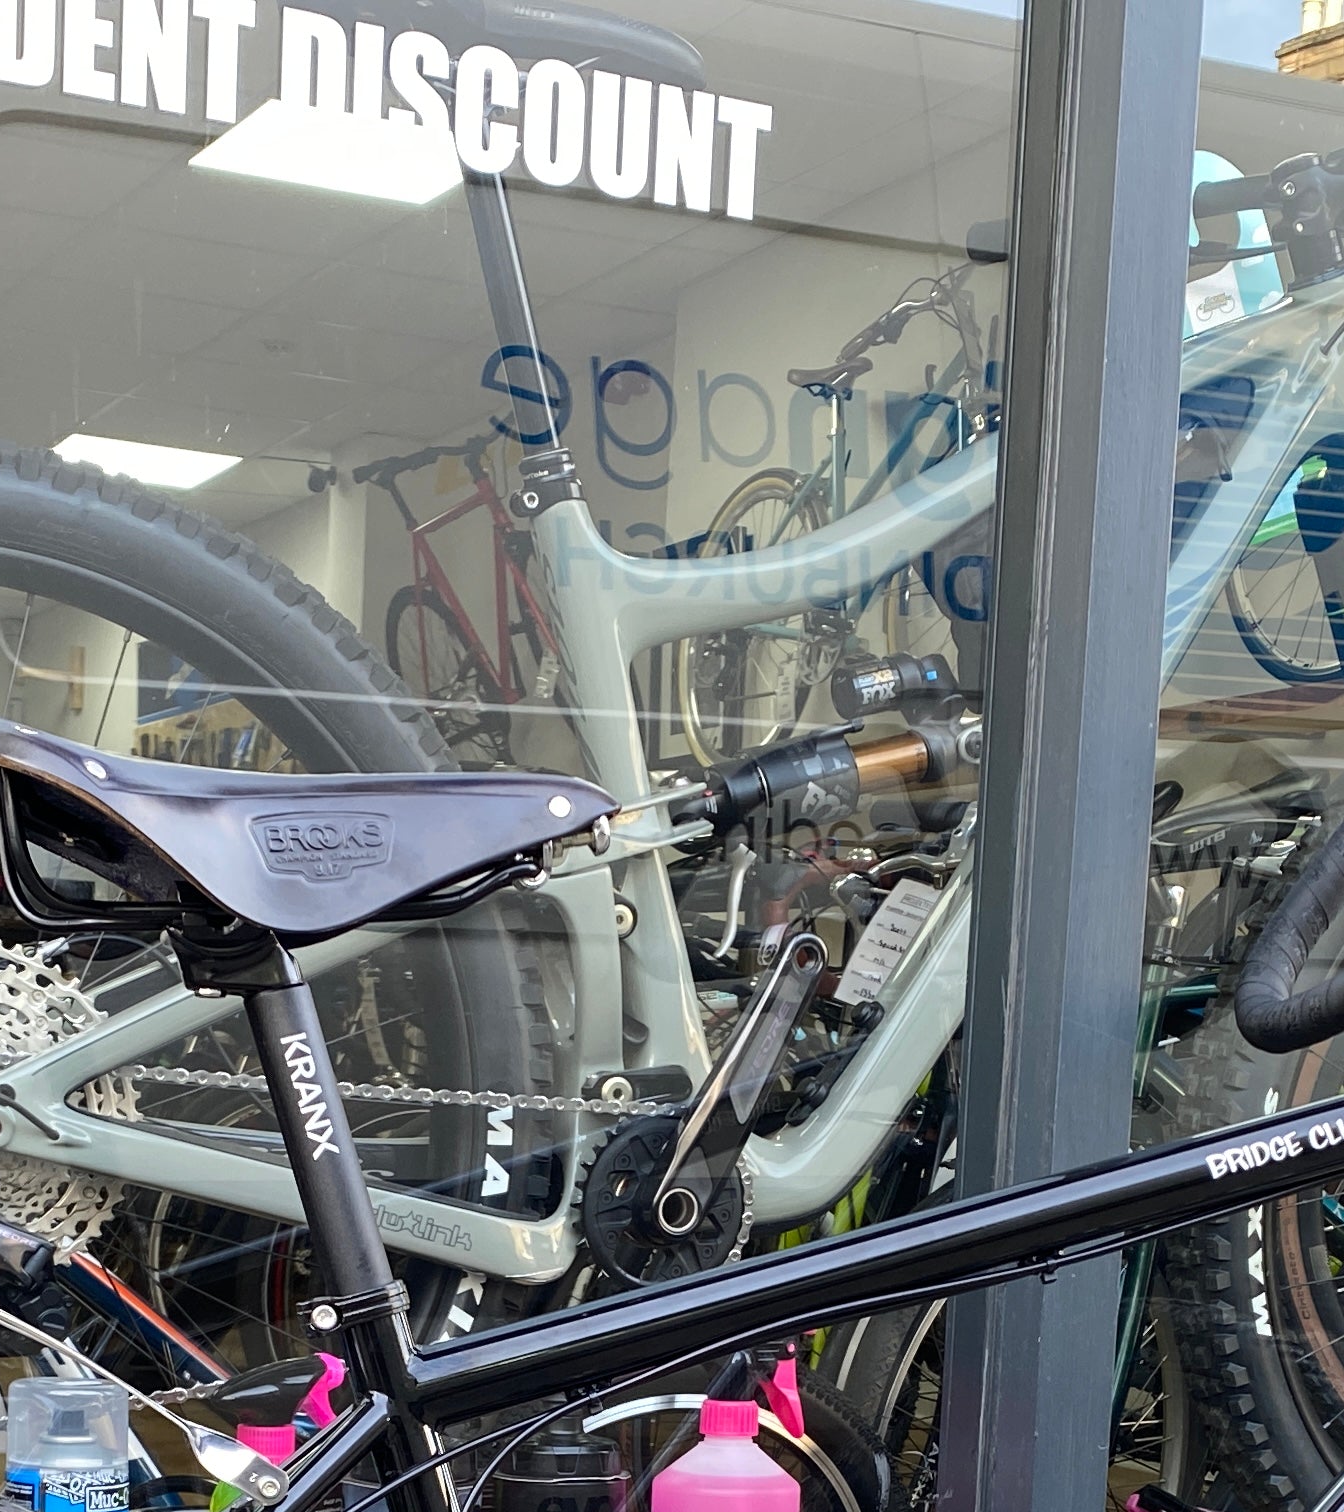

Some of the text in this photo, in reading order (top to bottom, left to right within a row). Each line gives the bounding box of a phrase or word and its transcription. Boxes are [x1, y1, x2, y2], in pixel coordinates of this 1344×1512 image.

[281, 6, 773, 221] DISCOUNT
[861, 680, 897, 704] FOX
[265, 821, 384, 853] BROOKS
[280, 1032, 340, 1161] KRANX
[1205, 1132, 1305, 1181] BRIDGE
